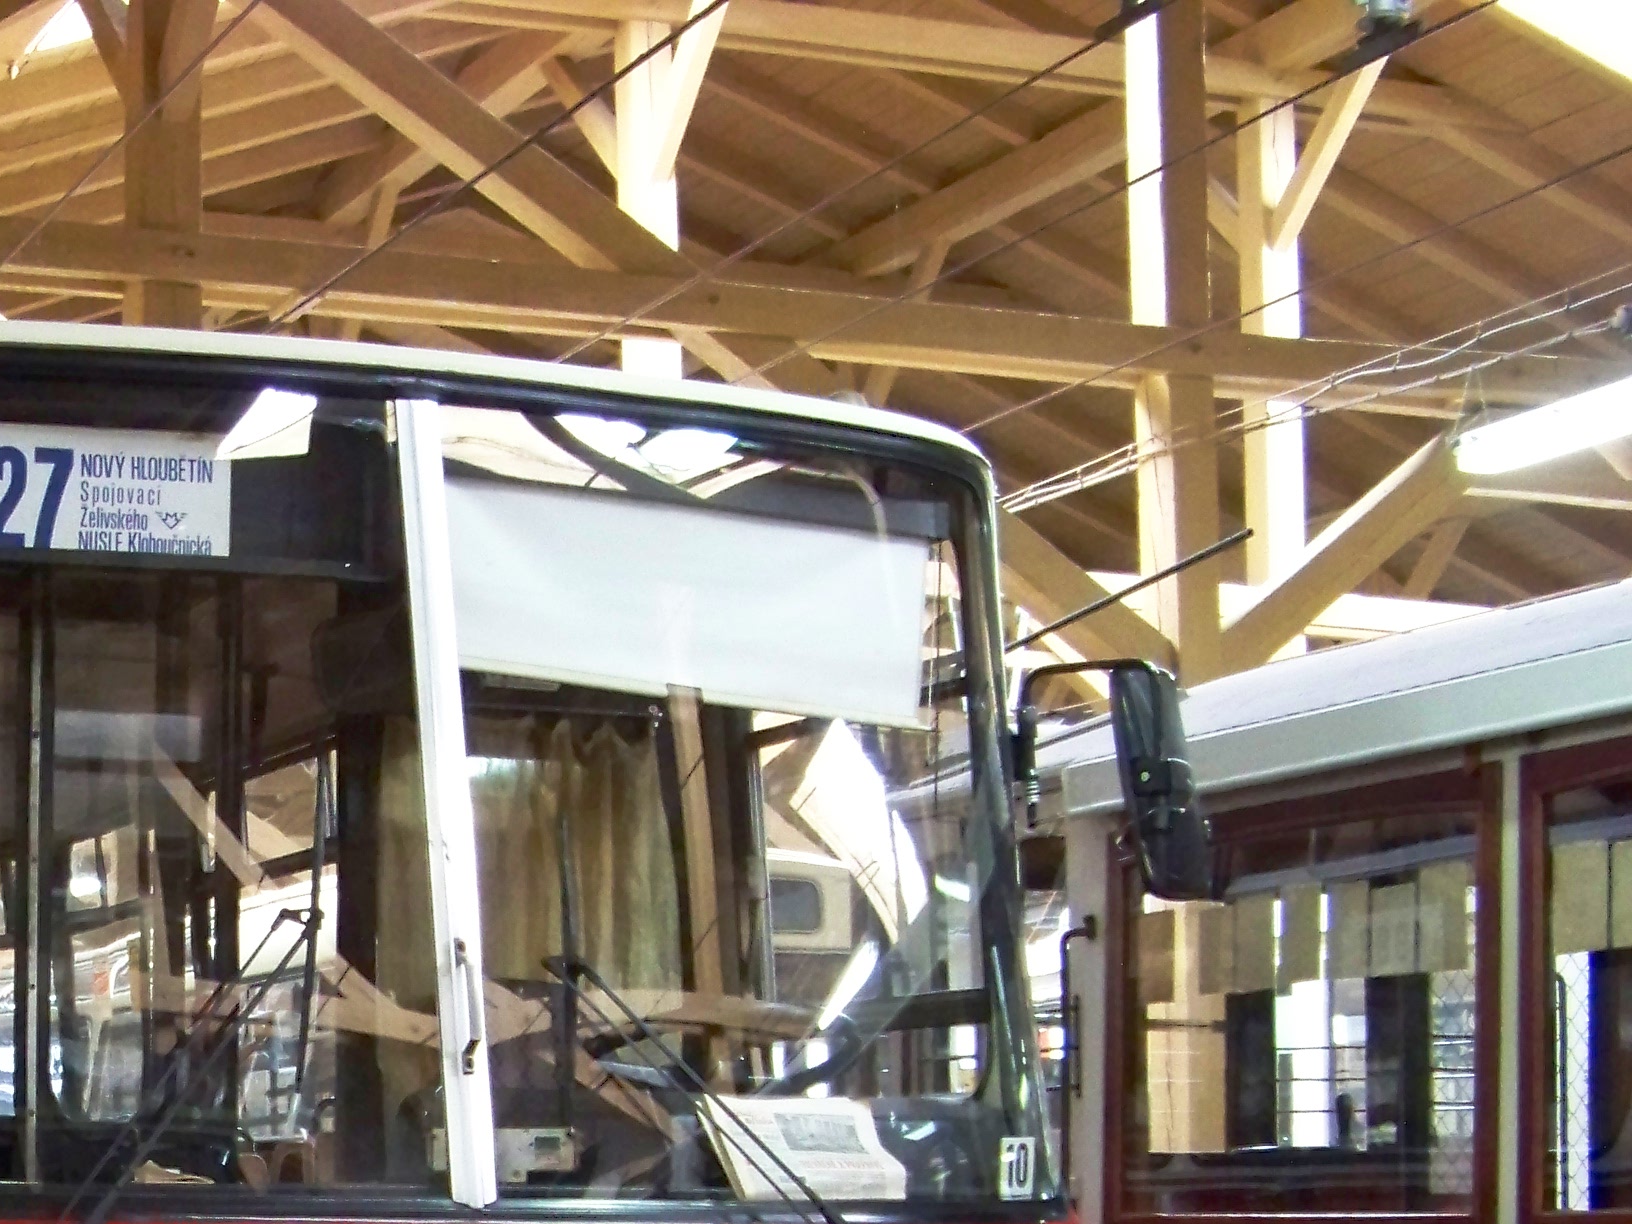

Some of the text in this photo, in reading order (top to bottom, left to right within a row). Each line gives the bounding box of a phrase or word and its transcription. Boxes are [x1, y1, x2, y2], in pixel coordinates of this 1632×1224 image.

[80, 451, 125, 479] NOVÝ
[80, 481, 161, 507] Spojovací
[80, 504, 148, 531] Želivského
[1006, 1142, 1029, 1189] 10
